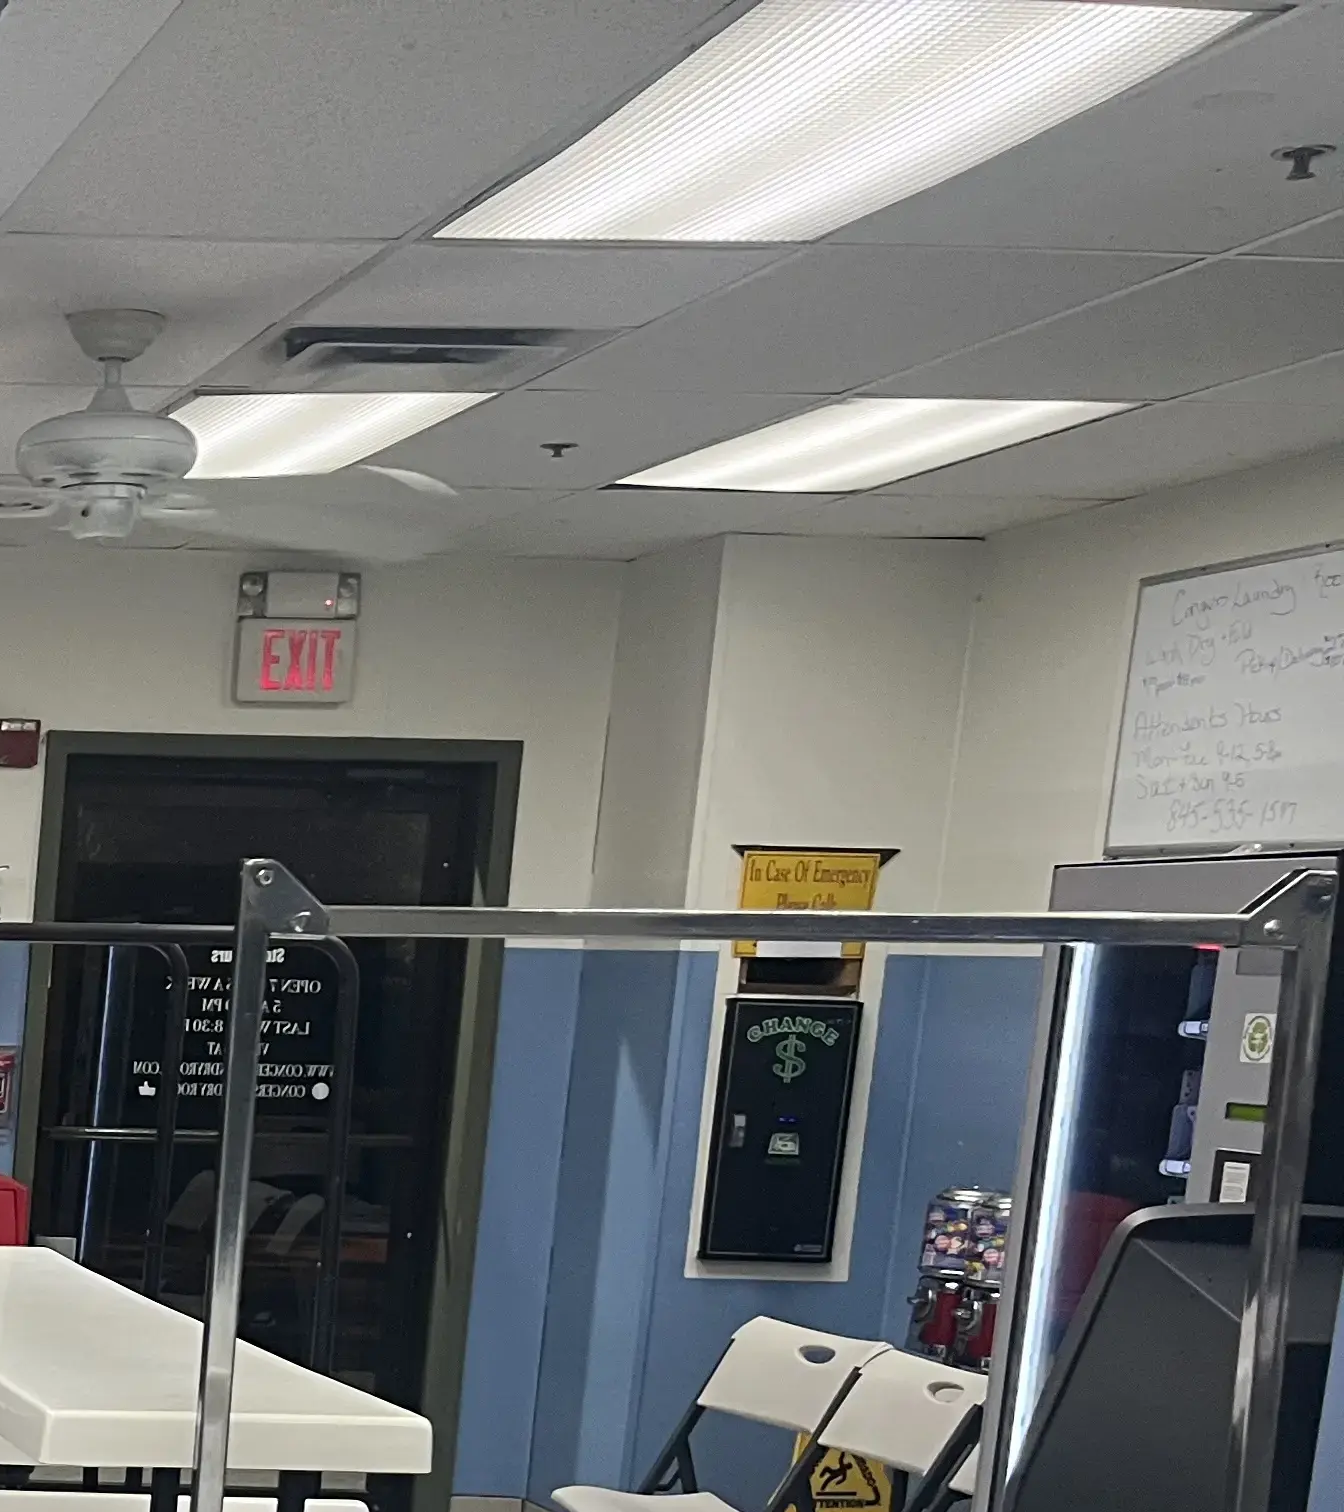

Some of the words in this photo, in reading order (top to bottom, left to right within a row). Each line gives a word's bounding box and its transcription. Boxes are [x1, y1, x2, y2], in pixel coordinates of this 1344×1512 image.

[260, 629, 341, 691] EXIT
[749, 860, 761, 882] In
[766, 860, 791, 882] Case
[795, 860, 812, 883] Of
[813, 860, 872, 887] Emergency
[746, 1016, 840, 1047] CHANGE
